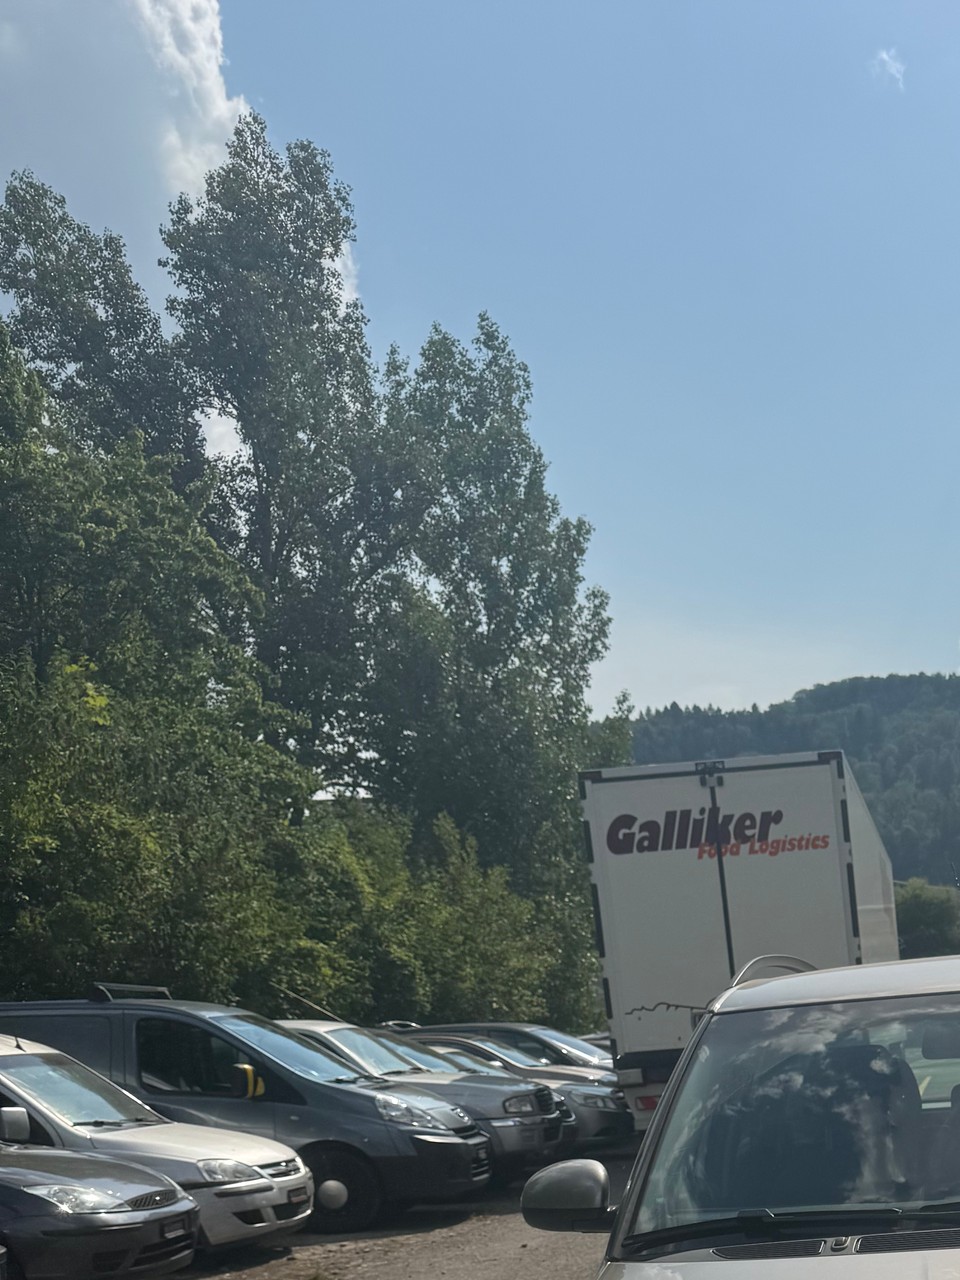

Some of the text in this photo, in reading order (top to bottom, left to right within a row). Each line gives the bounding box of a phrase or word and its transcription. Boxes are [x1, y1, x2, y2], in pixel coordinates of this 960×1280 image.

[606, 806, 783, 856] Galliker
[697, 832, 830, 860] Food Logistics
